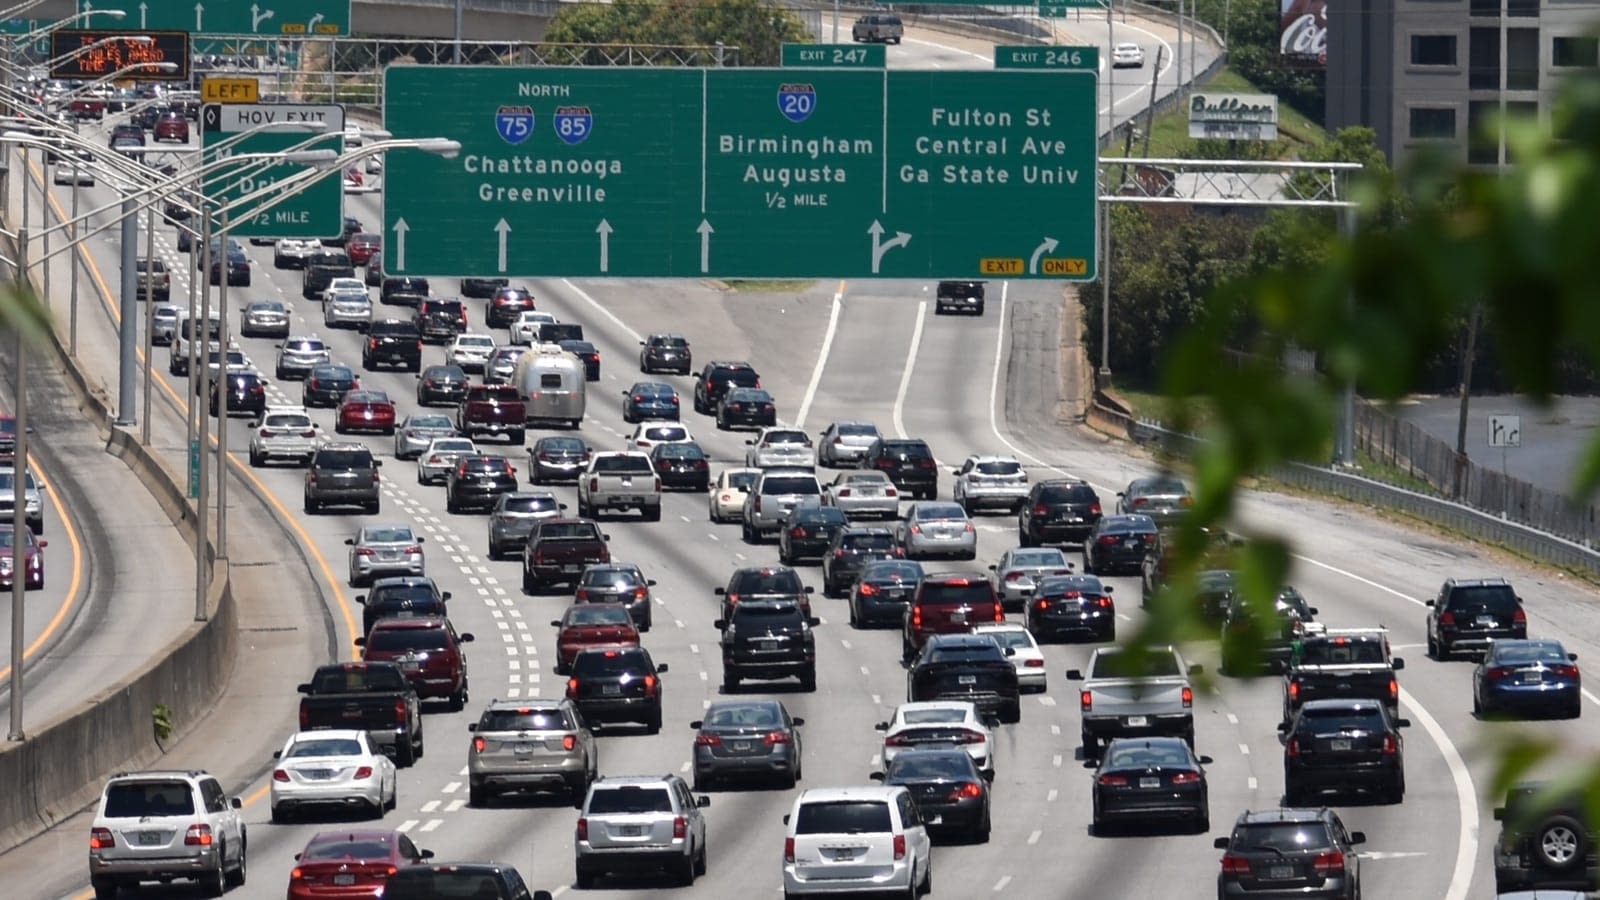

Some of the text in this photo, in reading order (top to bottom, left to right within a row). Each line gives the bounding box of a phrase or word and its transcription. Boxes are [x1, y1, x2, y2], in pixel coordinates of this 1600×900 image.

[799, 49, 867, 63] EXIT 247
[1012, 51, 1082, 65] EXIT 246
[207, 84, 251, 98] LEFT
[785, 95, 810, 113] 20
[238, 111, 325, 124] HOV EXIT
[932, 107, 1051, 127] Fulton St
[502, 117, 586, 136] 75 85
[719, 134, 873, 160] Birmingham
[915, 136, 1066, 155] Central Ave
[463, 155, 622, 179] Chattanooga
[743, 164, 846, 188] Augusta
[899, 164, 1079, 184] Ga State Univ
[479, 183, 606, 202] Greenville
[793, 194, 828, 206] MILE
[275, 211, 310, 223] MILE
[986, 261, 1084, 273] EXIT ONLY
